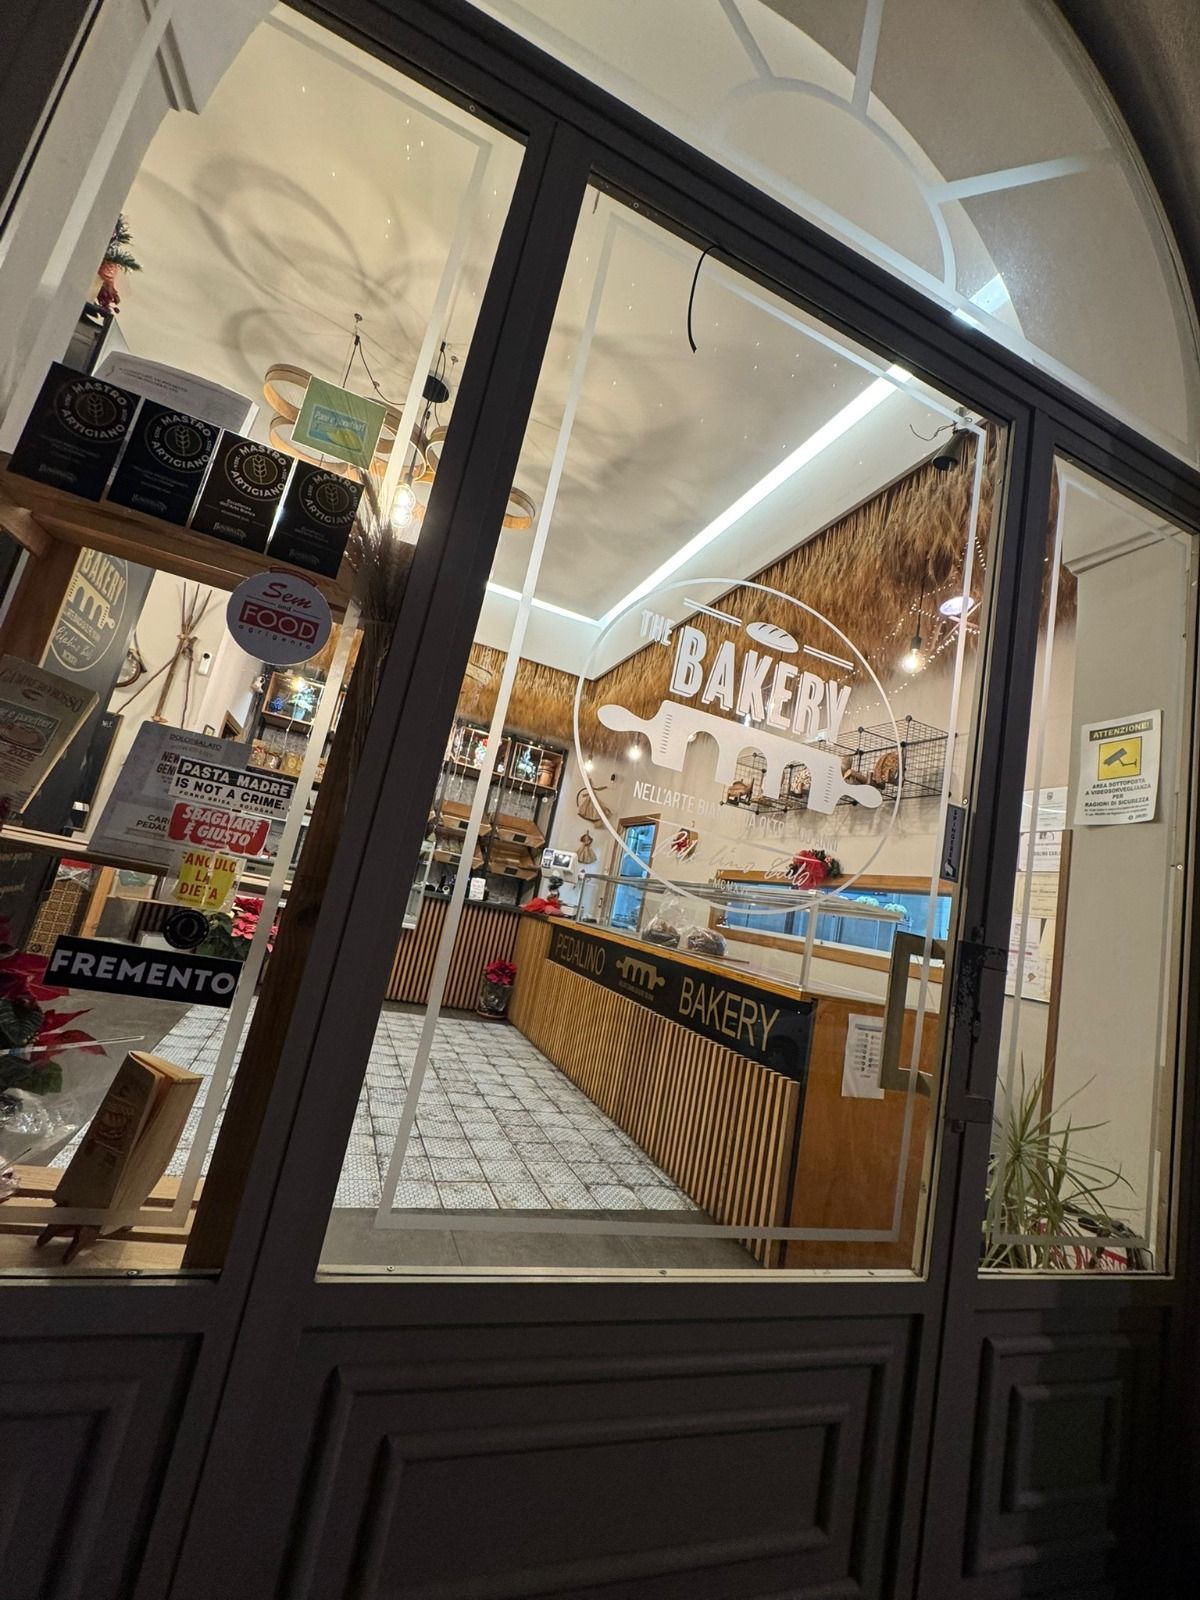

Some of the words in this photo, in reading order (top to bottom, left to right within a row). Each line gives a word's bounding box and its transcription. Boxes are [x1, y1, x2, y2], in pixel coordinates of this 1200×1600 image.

[72, 381, 127, 406] MASTRO
[62, 408, 125, 438] ARTIGIANO
[160, 415, 211, 436] MASTRO
[152, 440, 210, 469] ARTIGIANO
[240, 444, 287, 466] MASTRO
[230, 470, 286, 497] ARTIGIANO
[312, 473, 358, 494] MASTRO
[305, 498, 357, 524] ARTIGIANO
[81, 547, 126, 606] BAKERY
[243, 604, 315, 639] FOOD
[641, 609, 675, 646] THE
[669, 625, 852, 746] BAKERY
[1093, 721, 1150, 739] ATTENZIONE!
[175, 777, 189, 788] IS
[193, 781, 222, 796] NOT
[228, 789, 235, 799] A
[240, 793, 285, 810] CRIME.
[181, 762, 230, 783] PASTA
[236, 775, 290, 797] MADRE
[633, 781, 694, 813] NELL'ARTE
[1118, 797, 1149, 805] SICUREZZA
[182, 806, 262, 834] SBAGLIARE
[197, 826, 252, 846] GIUSTO
[50, 949, 236, 995] FREMENTO
[555, 933, 606, 976] PEDALINO
[678, 975, 780, 1052] BAKERY
